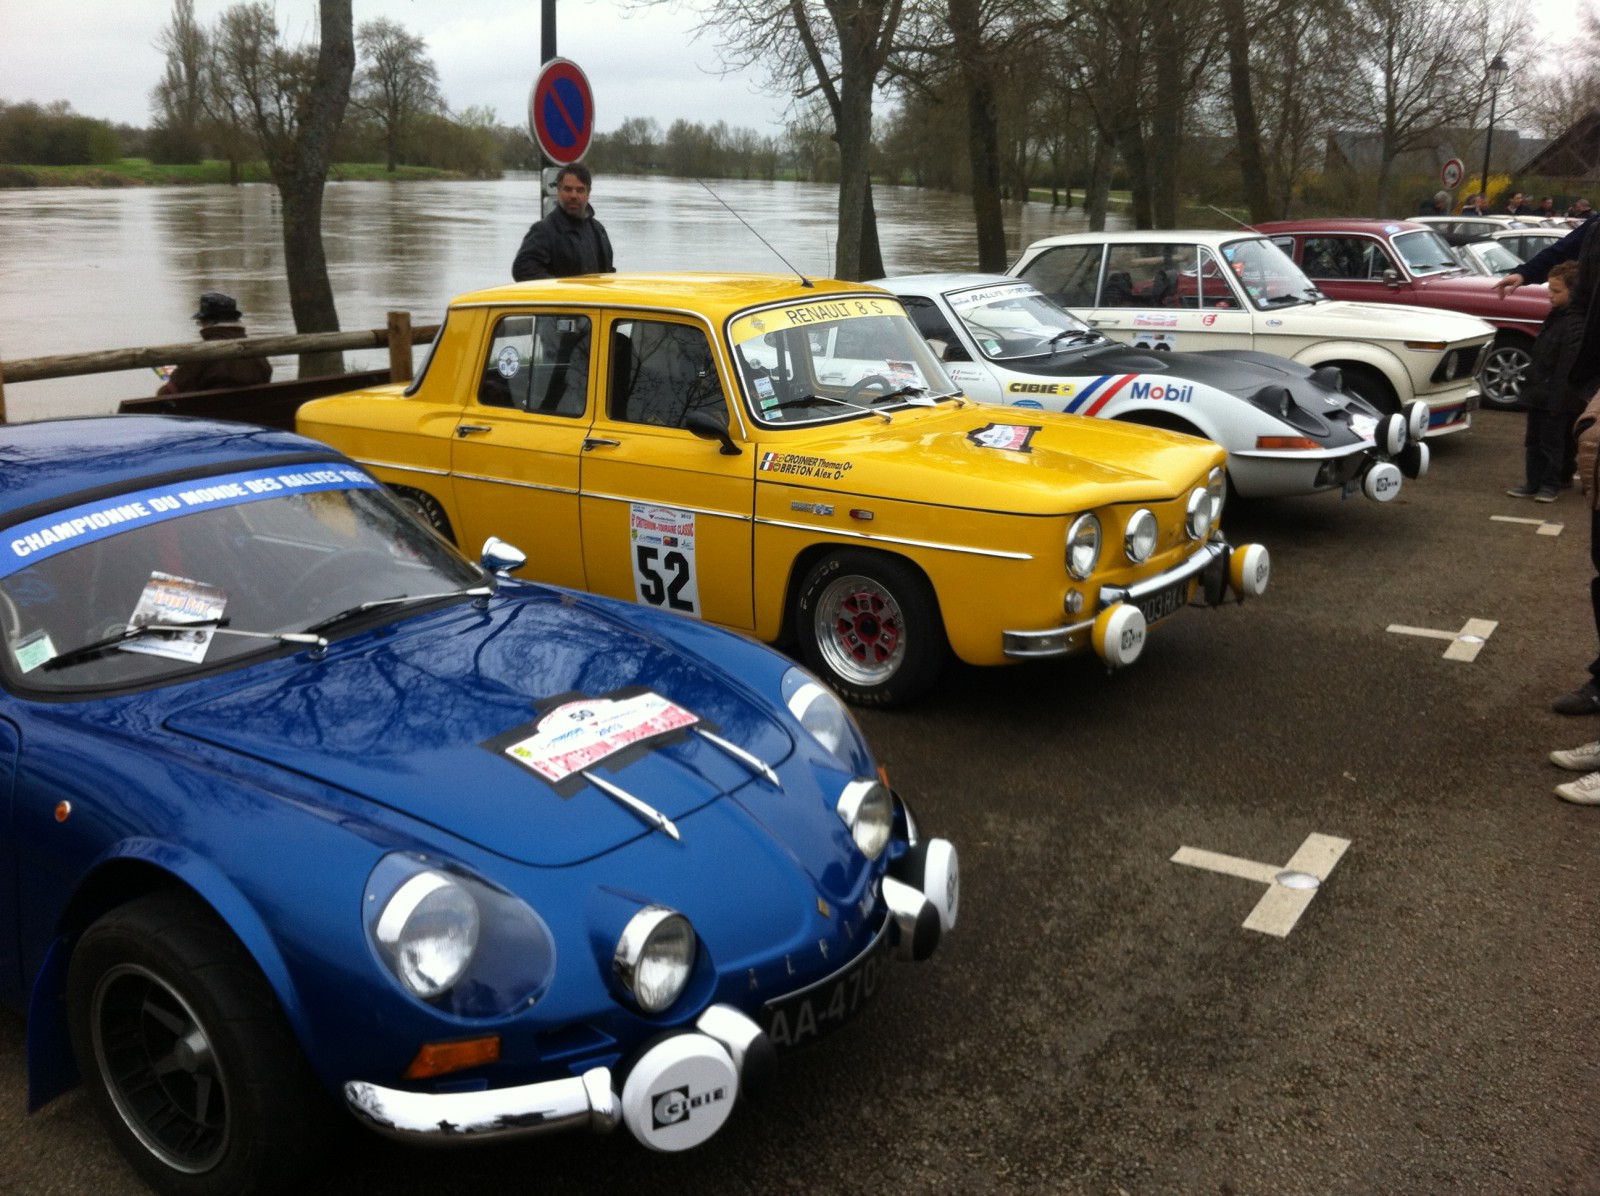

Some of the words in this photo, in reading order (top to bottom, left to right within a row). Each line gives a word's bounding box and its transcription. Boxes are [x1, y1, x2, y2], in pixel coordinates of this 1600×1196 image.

[785, 303, 851, 324] RENAULT
[855, 301, 868, 315] 8
[870, 300, 883, 314] S
[1009, 383, 1059, 394] CIBIE
[1130, 382, 1193, 403] Mobil
[780, 463, 813, 476] BRETON
[813, 468, 832, 479] Alex
[784, 454, 819, 467] CROSNIER
[818, 459, 843, 470] Thomas
[10, 502, 151, 557] CHAMPIONNE
[148, 495, 181, 512] DU
[179, 482, 248, 506] MONDE
[243, 478, 283, 493] DES
[278, 470, 344, 488] RALLYES
[637, 545, 694, 612] 52
[568, 709, 595, 722] 50
[663, 1085, 728, 1117] CIBIE
